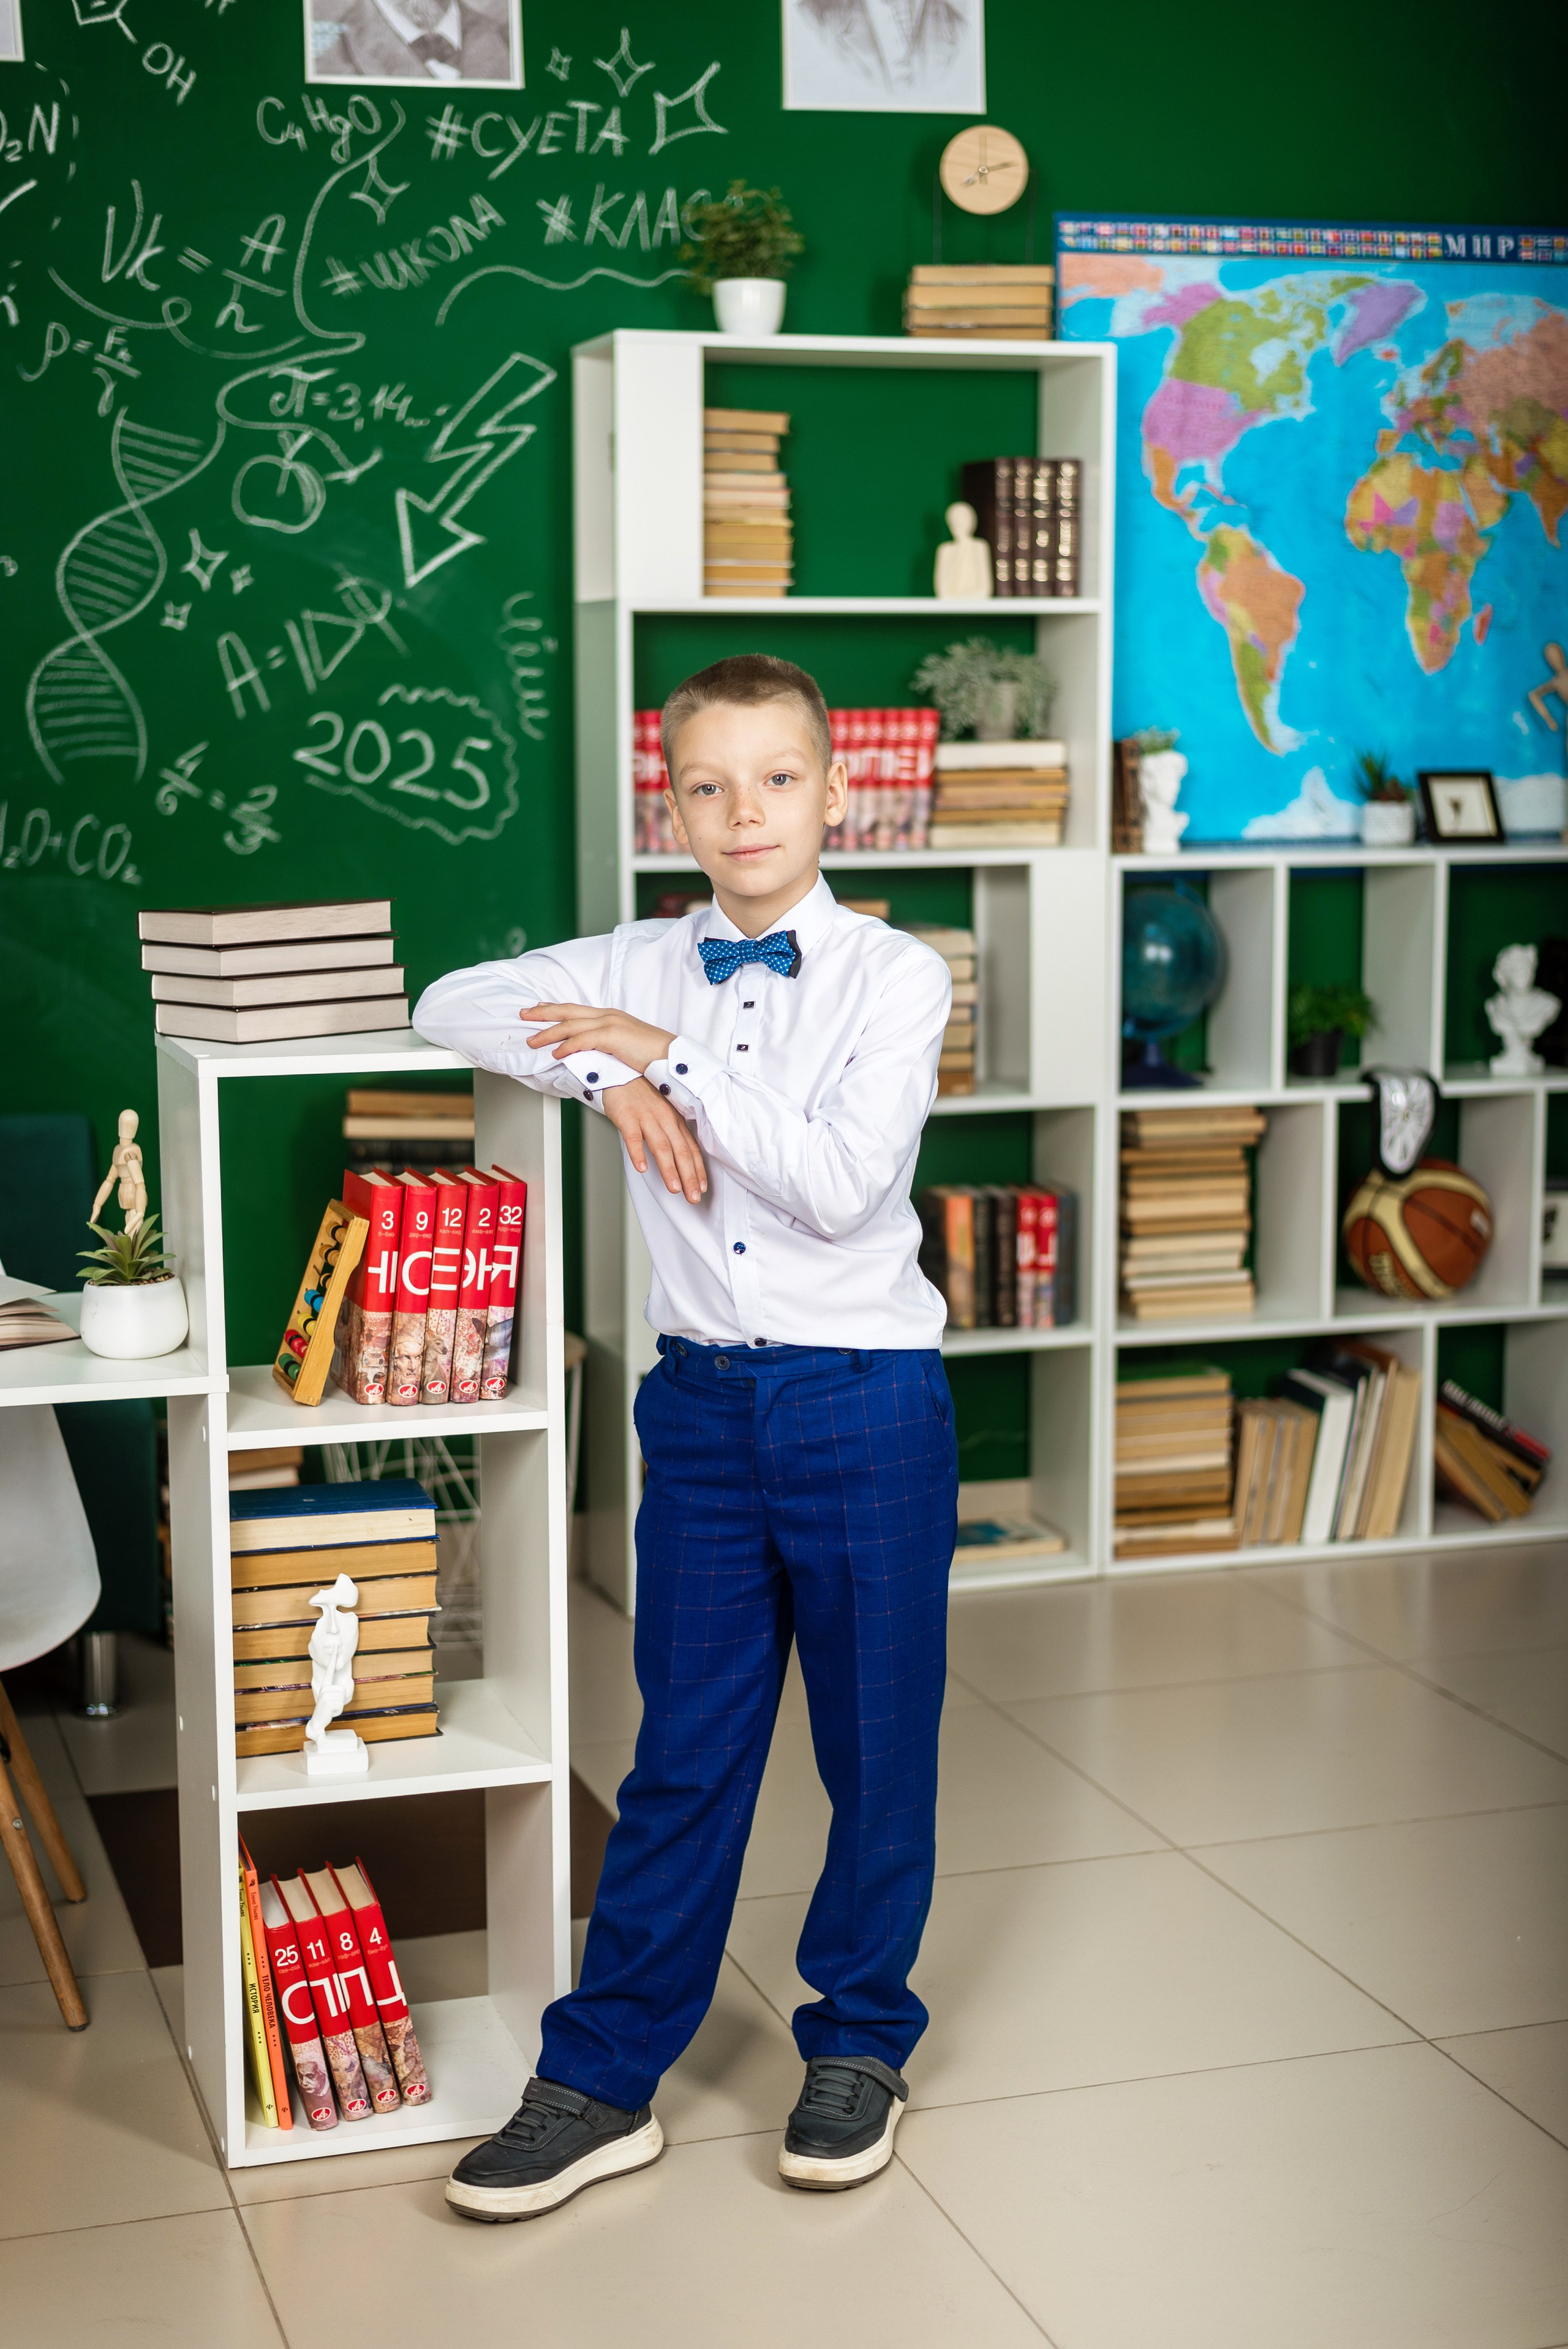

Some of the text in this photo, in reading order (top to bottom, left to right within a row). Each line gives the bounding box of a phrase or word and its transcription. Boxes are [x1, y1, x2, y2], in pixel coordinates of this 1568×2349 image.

[426, 100, 630, 180] #СУЕТА
[322, 194, 505, 298] #ШКОЛА
[1444, 234, 1515, 258] МИР
[293, 710, 492, 810] 2025
[382, 1210, 394, 1230] 3
[416, 1211, 428, 1231] 9
[442, 1207, 462, 1227] 12
[478, 1208, 491, 1226] 2
[499, 1205, 522, 1224] 32
[339, 1932, 353, 1951] 8
[369, 1927, 382, 1945] 4
[275, 1944, 298, 1967] 25
[307, 1939, 325, 1959] 11
[249, 1983, 260, 2013] ИСТОРИЯ
[265, 1993, 276, 2029] ЧЕЛОВЕКА
